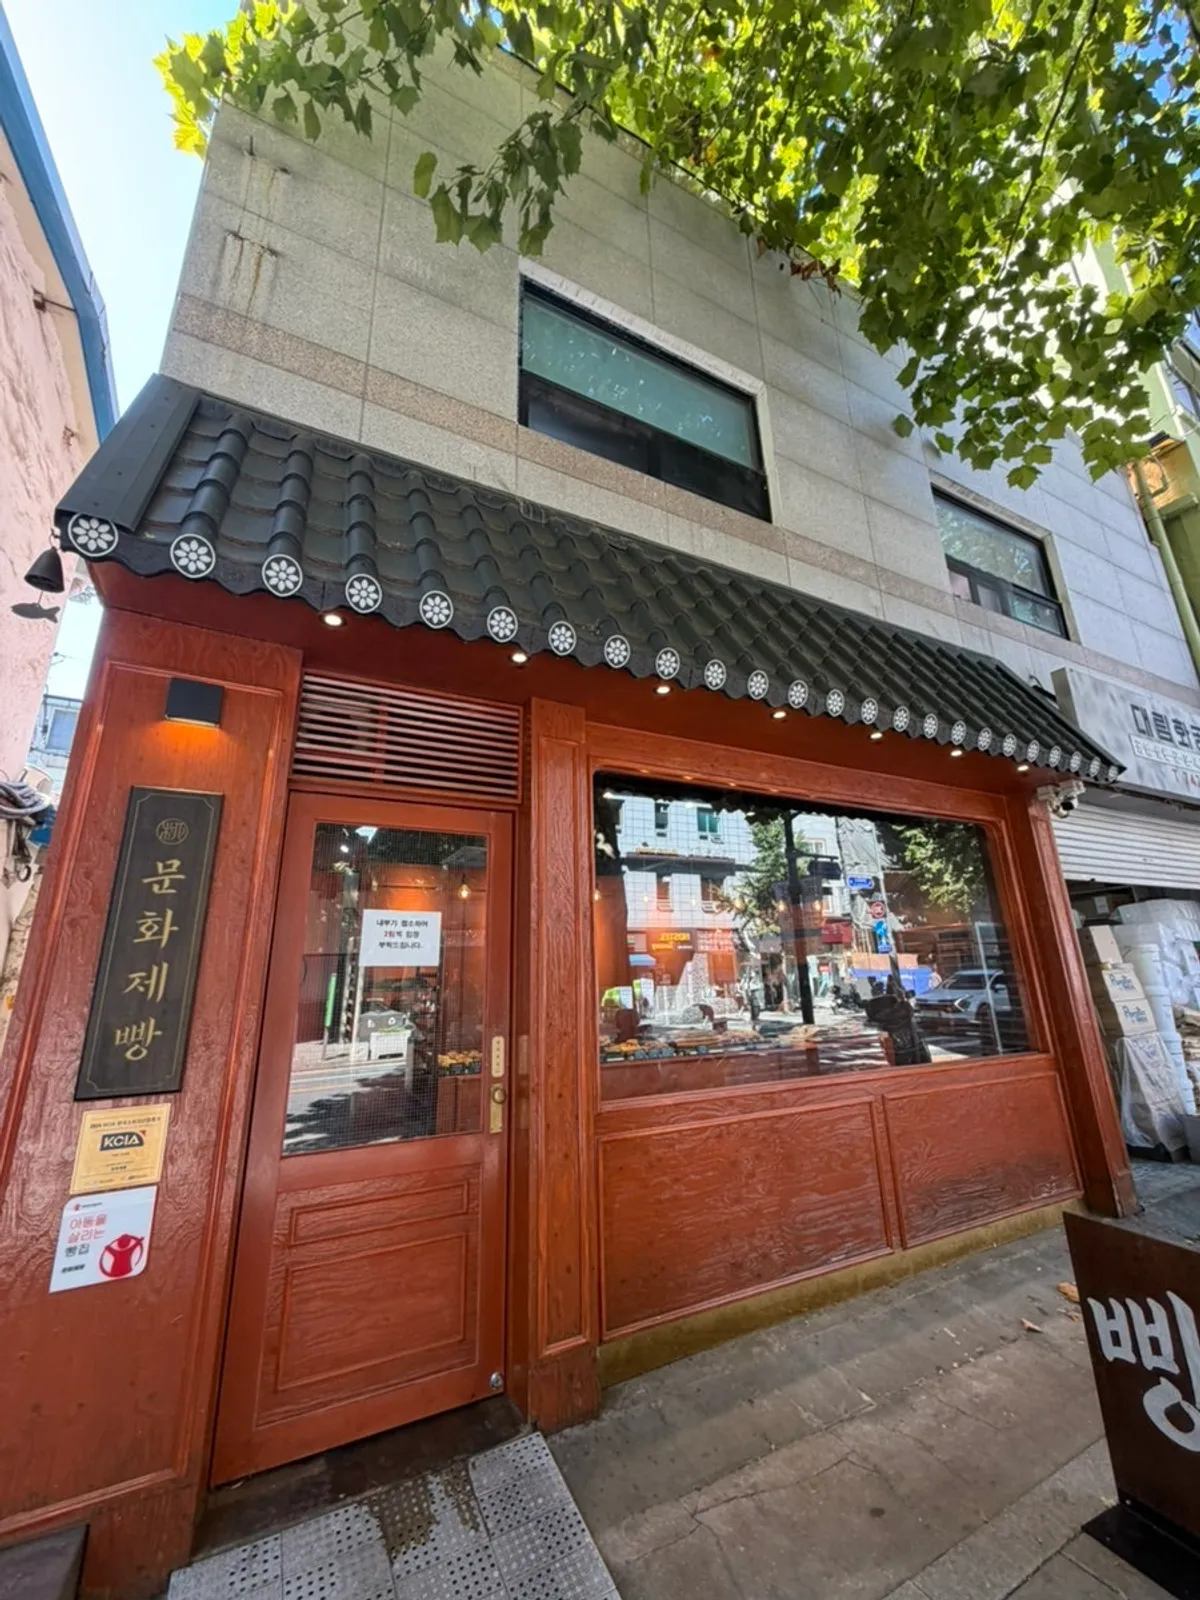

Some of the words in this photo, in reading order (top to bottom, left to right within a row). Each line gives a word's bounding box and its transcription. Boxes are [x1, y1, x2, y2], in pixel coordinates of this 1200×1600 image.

[376, 919, 398, 927] 내부가
[113, 858, 187, 1061] 문화제빵
[103, 1134, 140, 1148] KCIA
